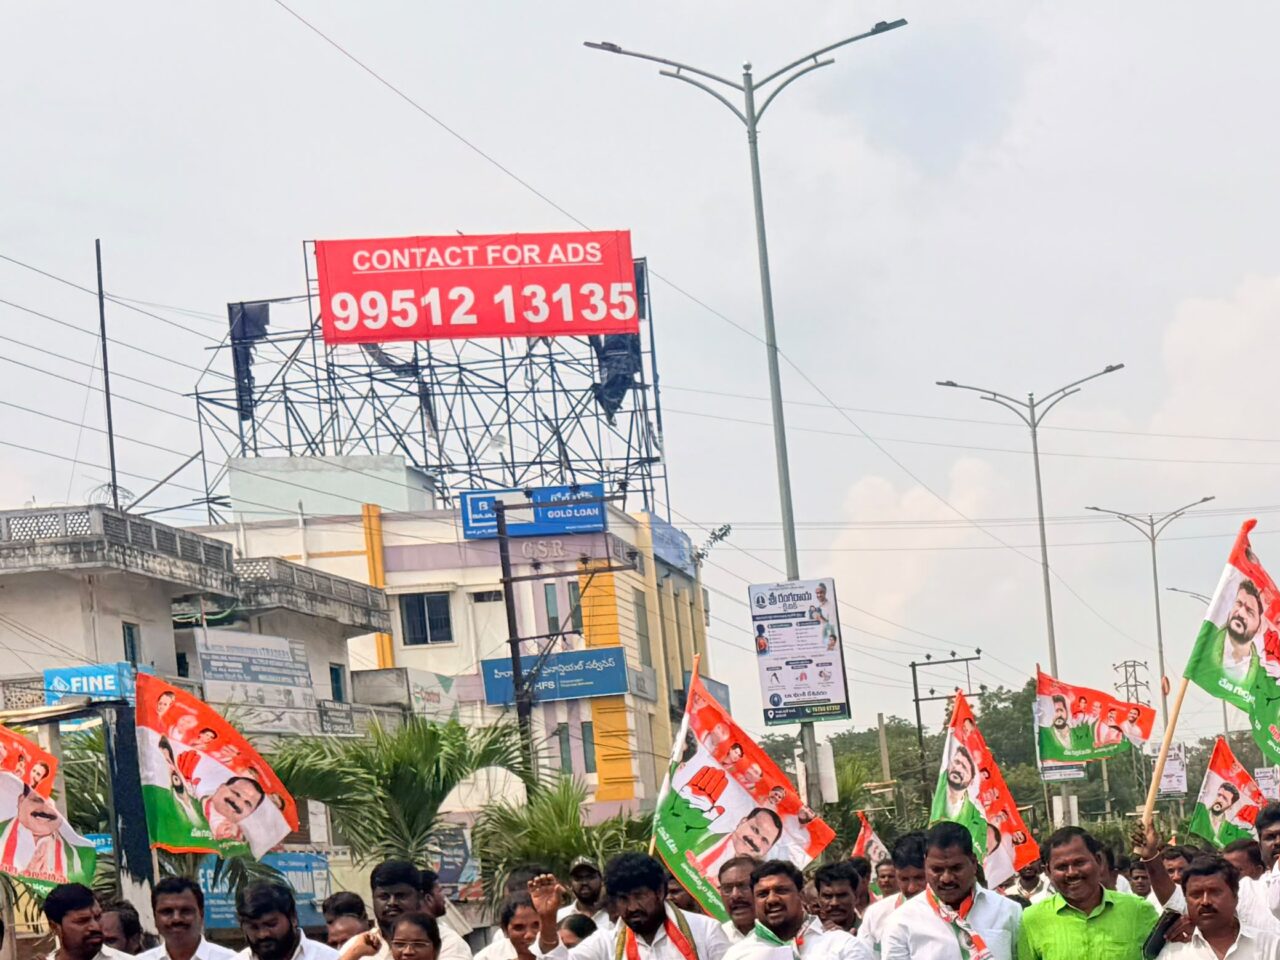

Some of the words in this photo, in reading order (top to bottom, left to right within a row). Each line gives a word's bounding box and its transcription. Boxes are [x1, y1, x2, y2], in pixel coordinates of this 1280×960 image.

[352, 246, 478, 271] CONTACT
[486, 244, 541, 265] FOR
[548, 242, 603, 263] ADS
[331, 286, 477, 331] 99512
[493, 282, 637, 324] 13135
[547, 509, 573, 519] GOLD
[574, 507, 599, 517] LOAN
[70, 675, 116, 692] FINE
